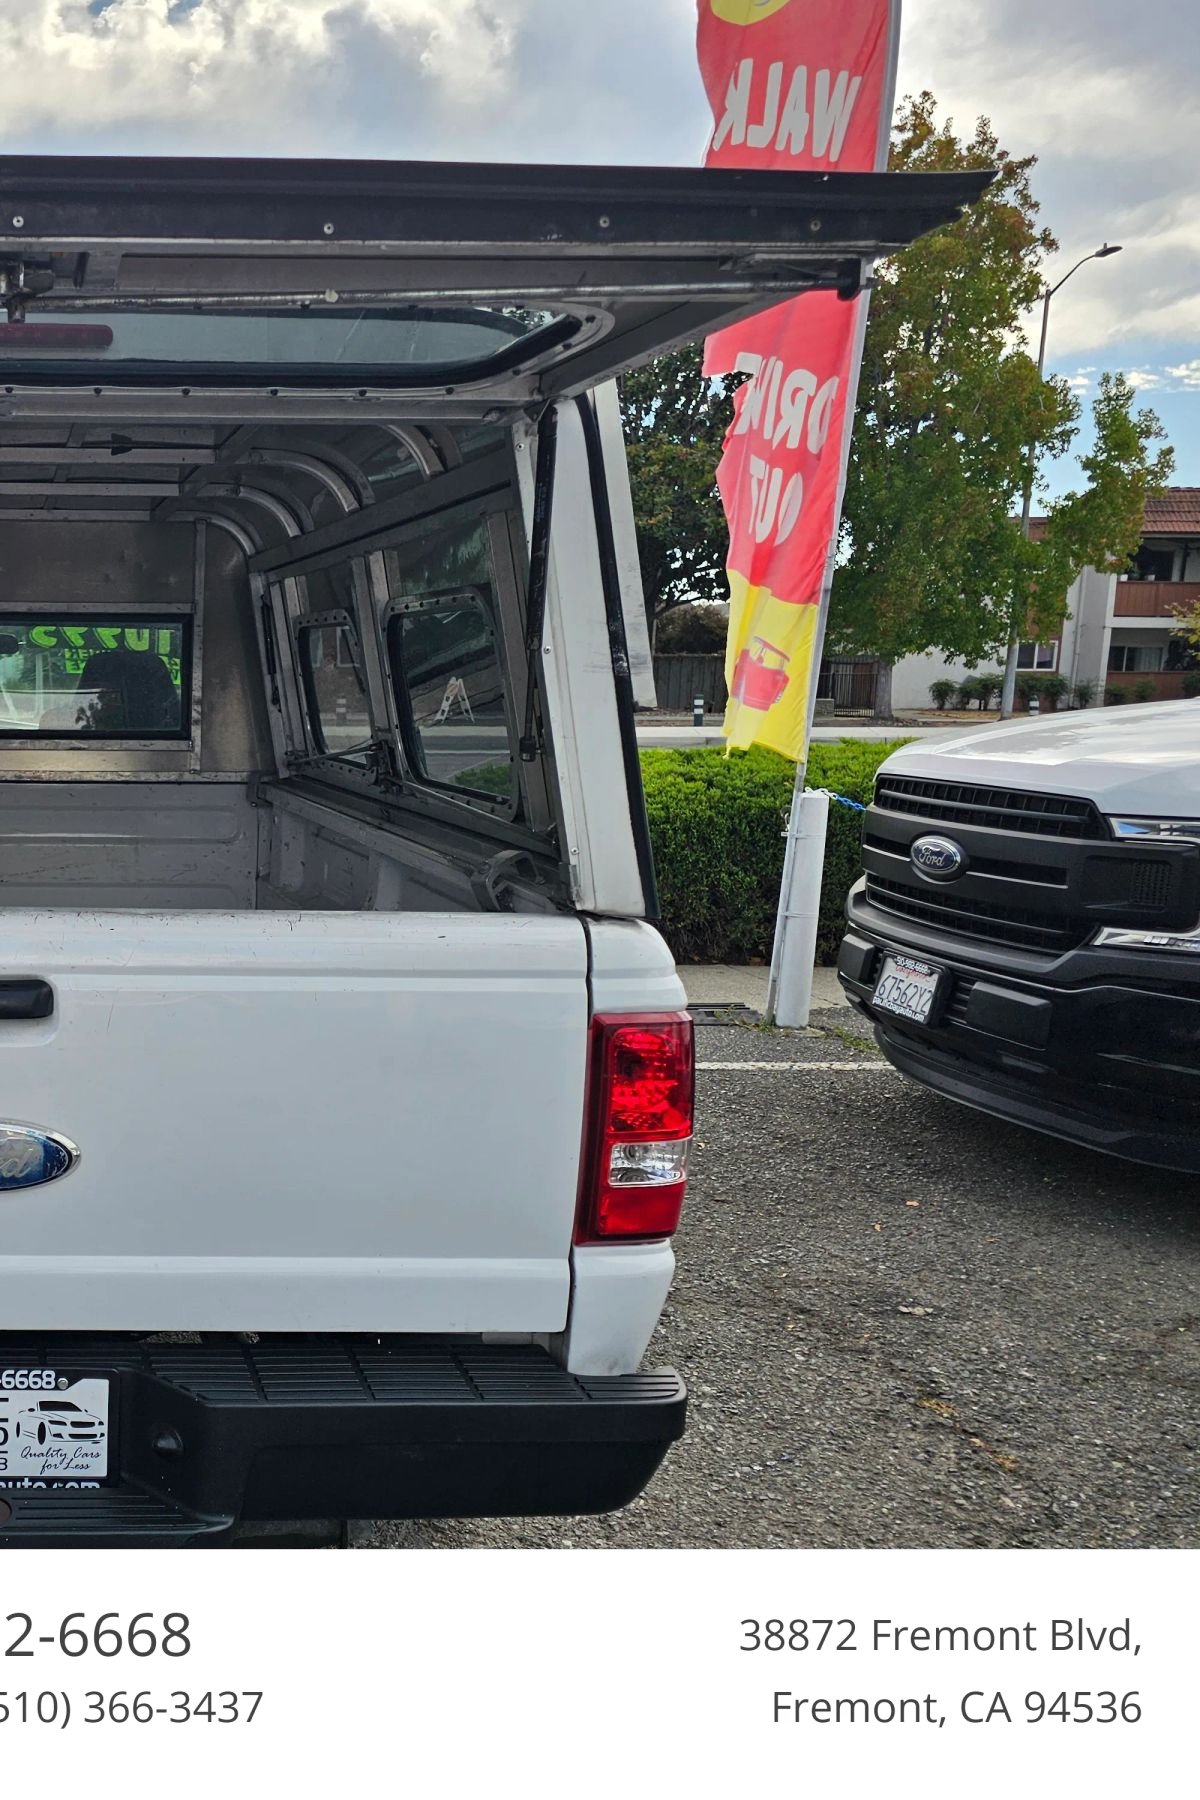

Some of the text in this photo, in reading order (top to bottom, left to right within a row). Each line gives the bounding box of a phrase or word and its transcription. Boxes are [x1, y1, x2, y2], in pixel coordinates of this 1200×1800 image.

[918, 845, 947, 867] Ford
[878, 975, 934, 1014] 67562Y2
[21, 1446, 102, 1465] Quality Cars
[40, 1458, 91, 1475] for Less
